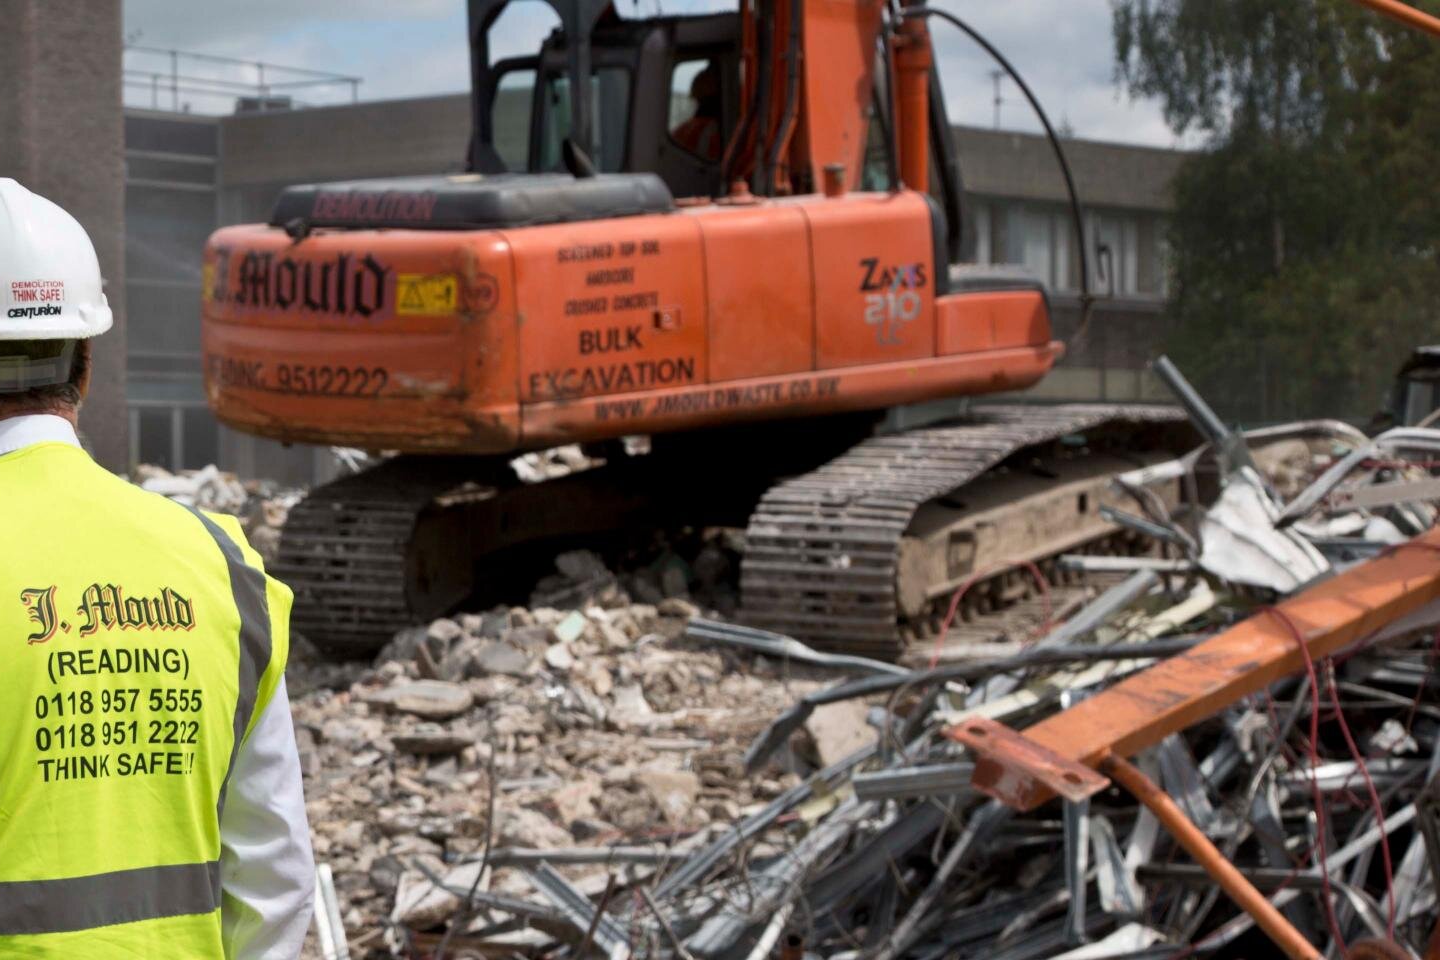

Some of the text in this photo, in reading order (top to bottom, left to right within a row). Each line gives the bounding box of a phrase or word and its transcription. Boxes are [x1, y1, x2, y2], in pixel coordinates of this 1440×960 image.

[11, 280, 64, 289] DEMOLITION
[12, 289, 38, 302] THINK
[40, 289, 60, 301] SAFE
[7, 303, 62, 319] CENTURION
[864, 291, 923, 325] 210
[579, 326, 643, 355] BULK
[528, 357, 695, 399] EXCAVATION
[20, 583, 196, 645] J. Mould
[47, 649, 189, 684] (READING)
[35, 688, 203, 719] 0118 957 5555
[35, 720, 200, 752] 0118 951 2222
[37, 754, 110, 783] THINK
